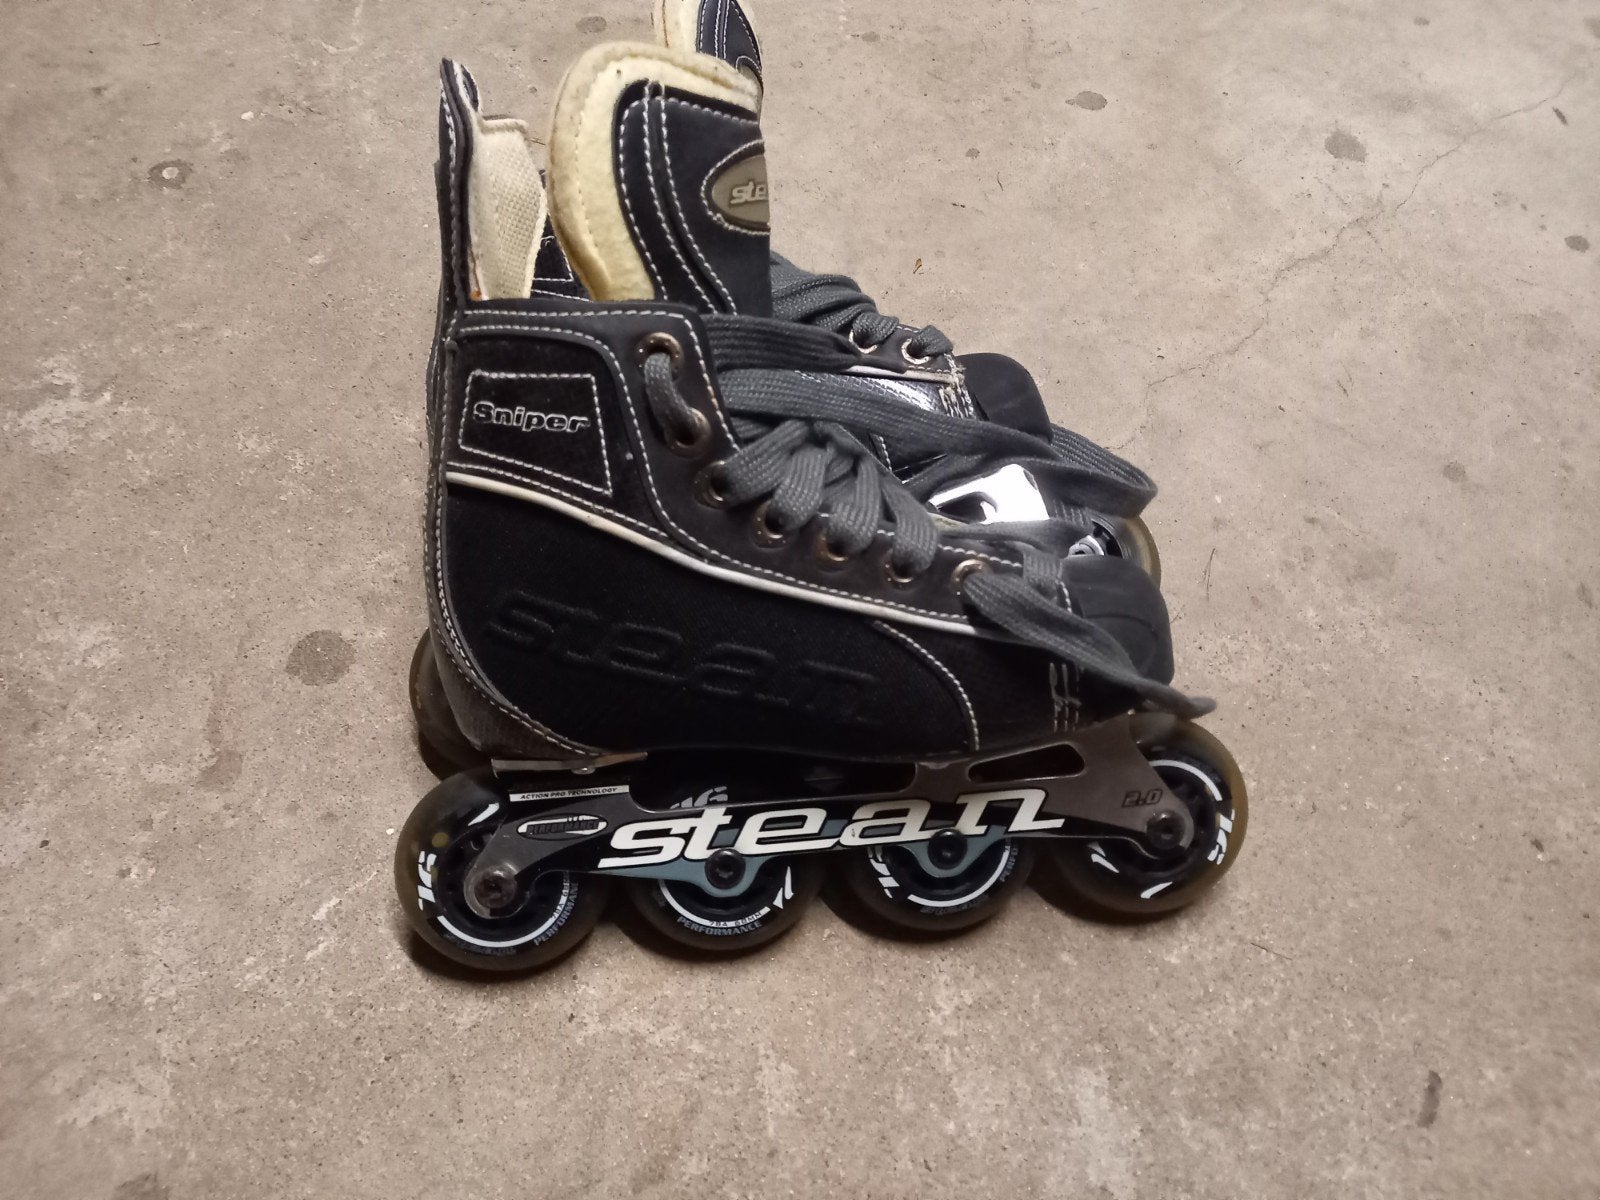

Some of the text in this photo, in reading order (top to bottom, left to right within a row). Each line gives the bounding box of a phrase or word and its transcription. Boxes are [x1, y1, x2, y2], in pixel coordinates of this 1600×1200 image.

[730, 181, 769, 204] ste
[473, 401, 591, 433] Sniper
[568, 787, 618, 797] TECHNOLOGY
[1121, 788, 1163, 808] 2.0
[598, 788, 1066, 868] stean
[676, 915, 763, 936] PERFORMANCE
